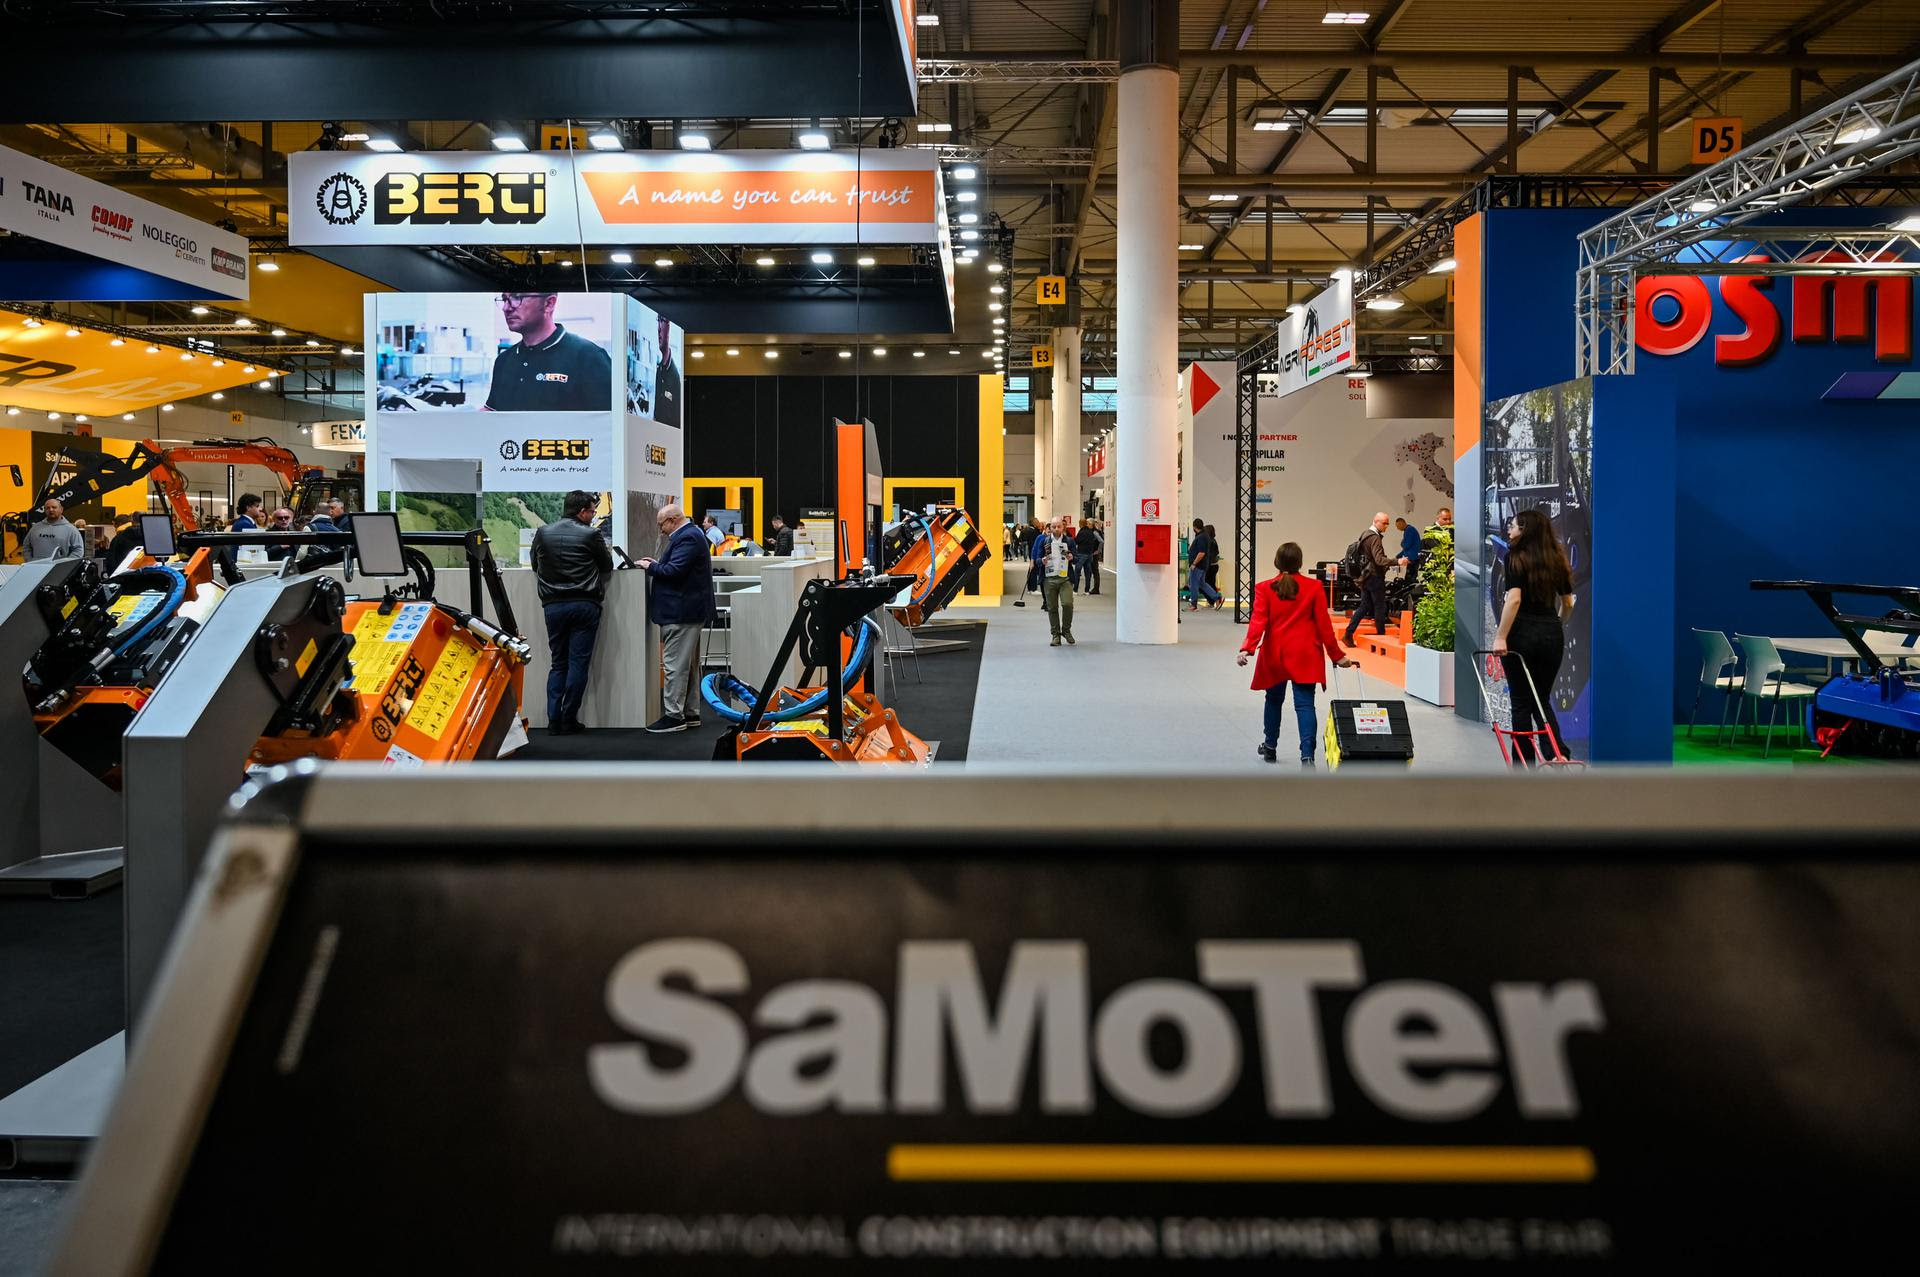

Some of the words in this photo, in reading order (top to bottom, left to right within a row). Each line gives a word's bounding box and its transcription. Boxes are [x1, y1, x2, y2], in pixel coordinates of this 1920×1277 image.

[1699, 126, 1734, 154] D5
[22, 180, 75, 216] TANA
[618, 184, 639, 206] A
[650, 186, 724, 205] name
[733, 187, 780, 211] you
[789, 186, 837, 205] can
[846, 185, 913, 206] trust
[37, 209, 60, 222] ITALIA
[142, 223, 198, 254] NOLEGGIO
[182, 252, 206, 266] CERVETTI
[1043, 283, 1060, 298] E4
[1036, 351, 1049, 363] E3
[232, 414, 242, 423] H2
[331, 423, 366, 441] FEM
[194, 453, 228, 461] HITACHI
[499, 465, 507, 473] A
[588, 938, 1605, 1117] SaMoTer
[858, 1214, 1157, 1257] CONSTRUCTION
[1161, 1214, 1382, 1257] EQUIPMENT
[1389, 1214, 1517, 1257] TRADE
